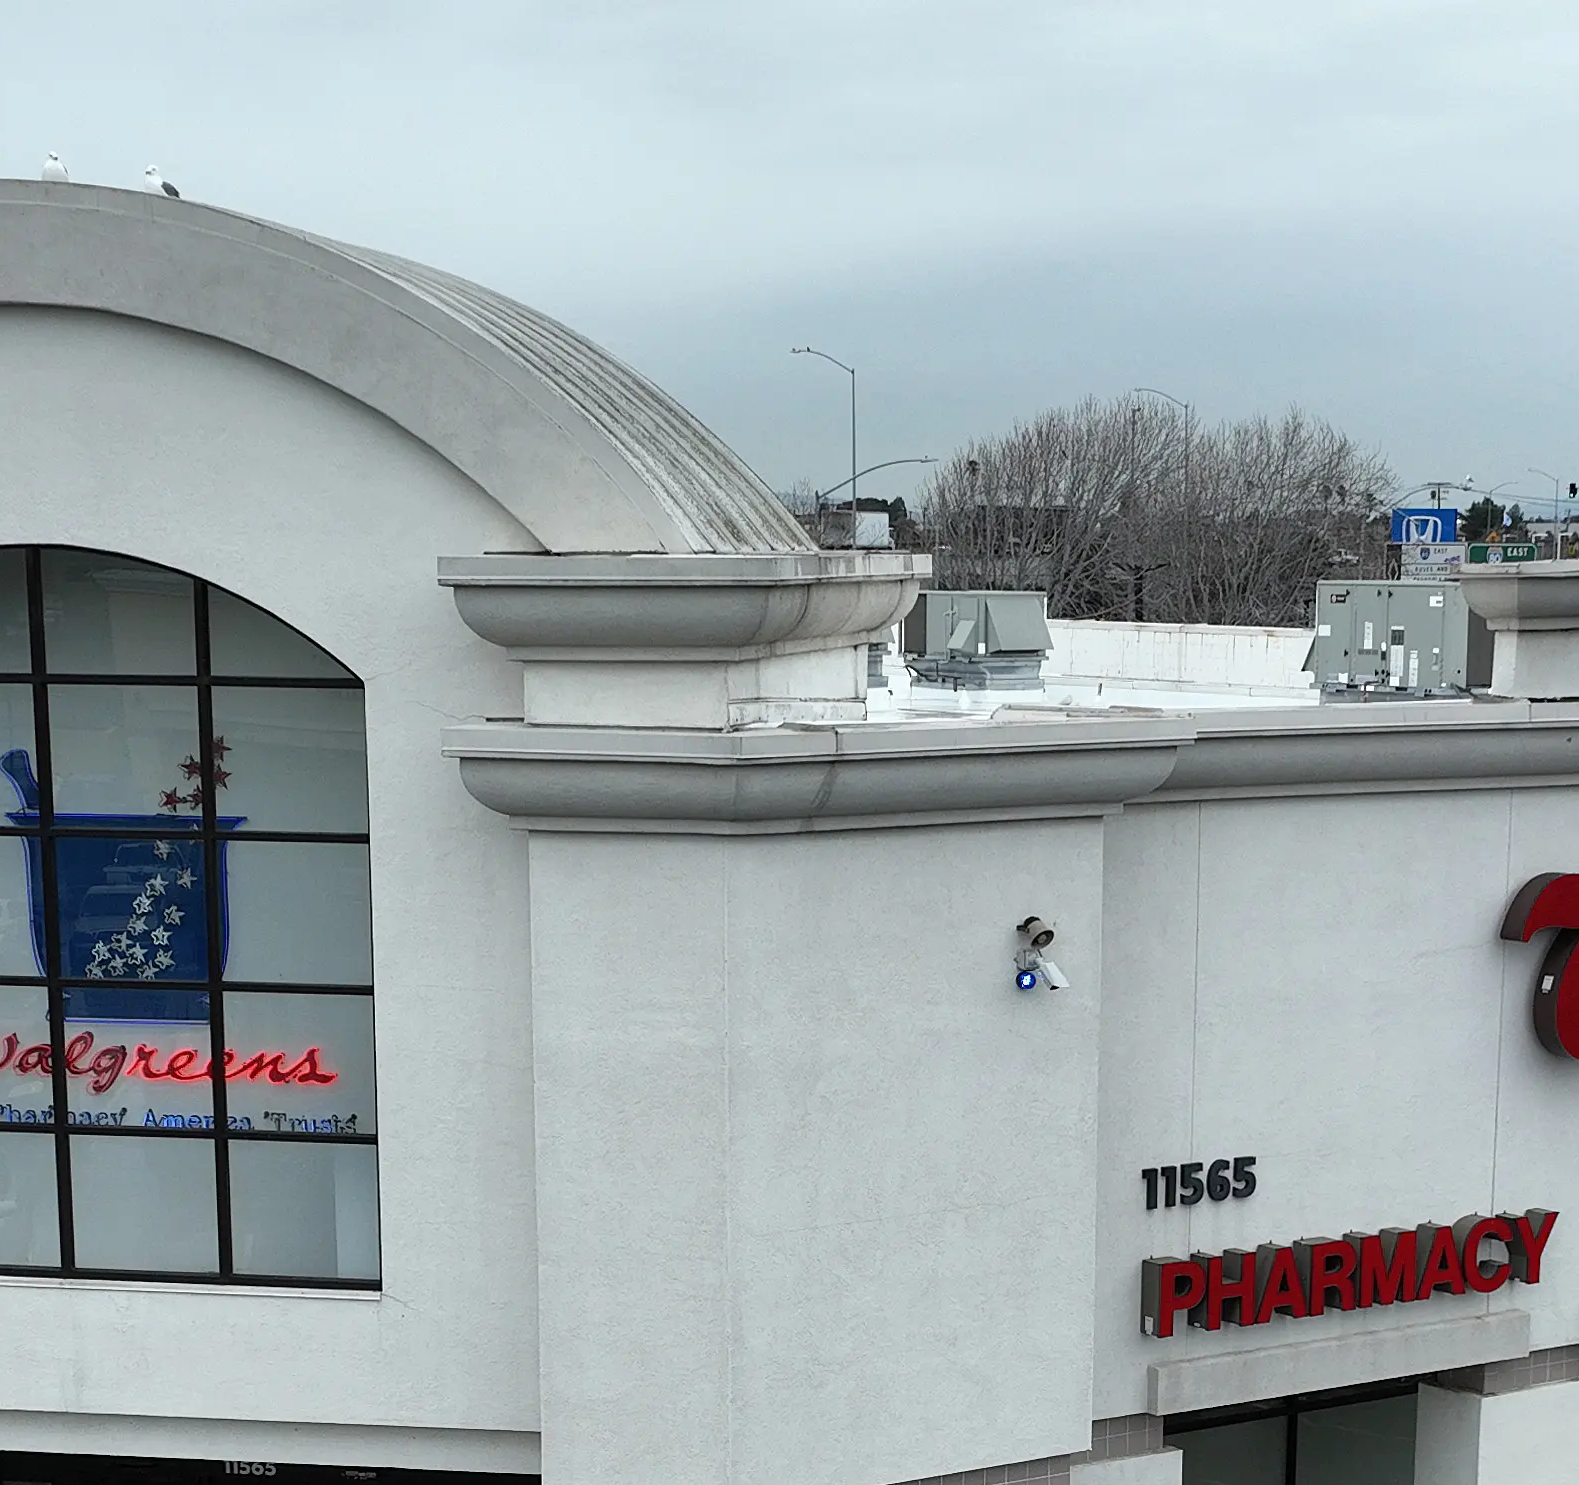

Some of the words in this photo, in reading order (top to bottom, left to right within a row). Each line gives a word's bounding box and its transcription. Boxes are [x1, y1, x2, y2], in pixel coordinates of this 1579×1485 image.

[1506, 547, 1529, 557] EAST
[142, 1109, 254, 1131] Amerca
[1141, 1156, 1257, 1210] 11565
[1141, 1208, 1560, 1339] PHARMACY
[225, 1461, 277, 1476] 11565
